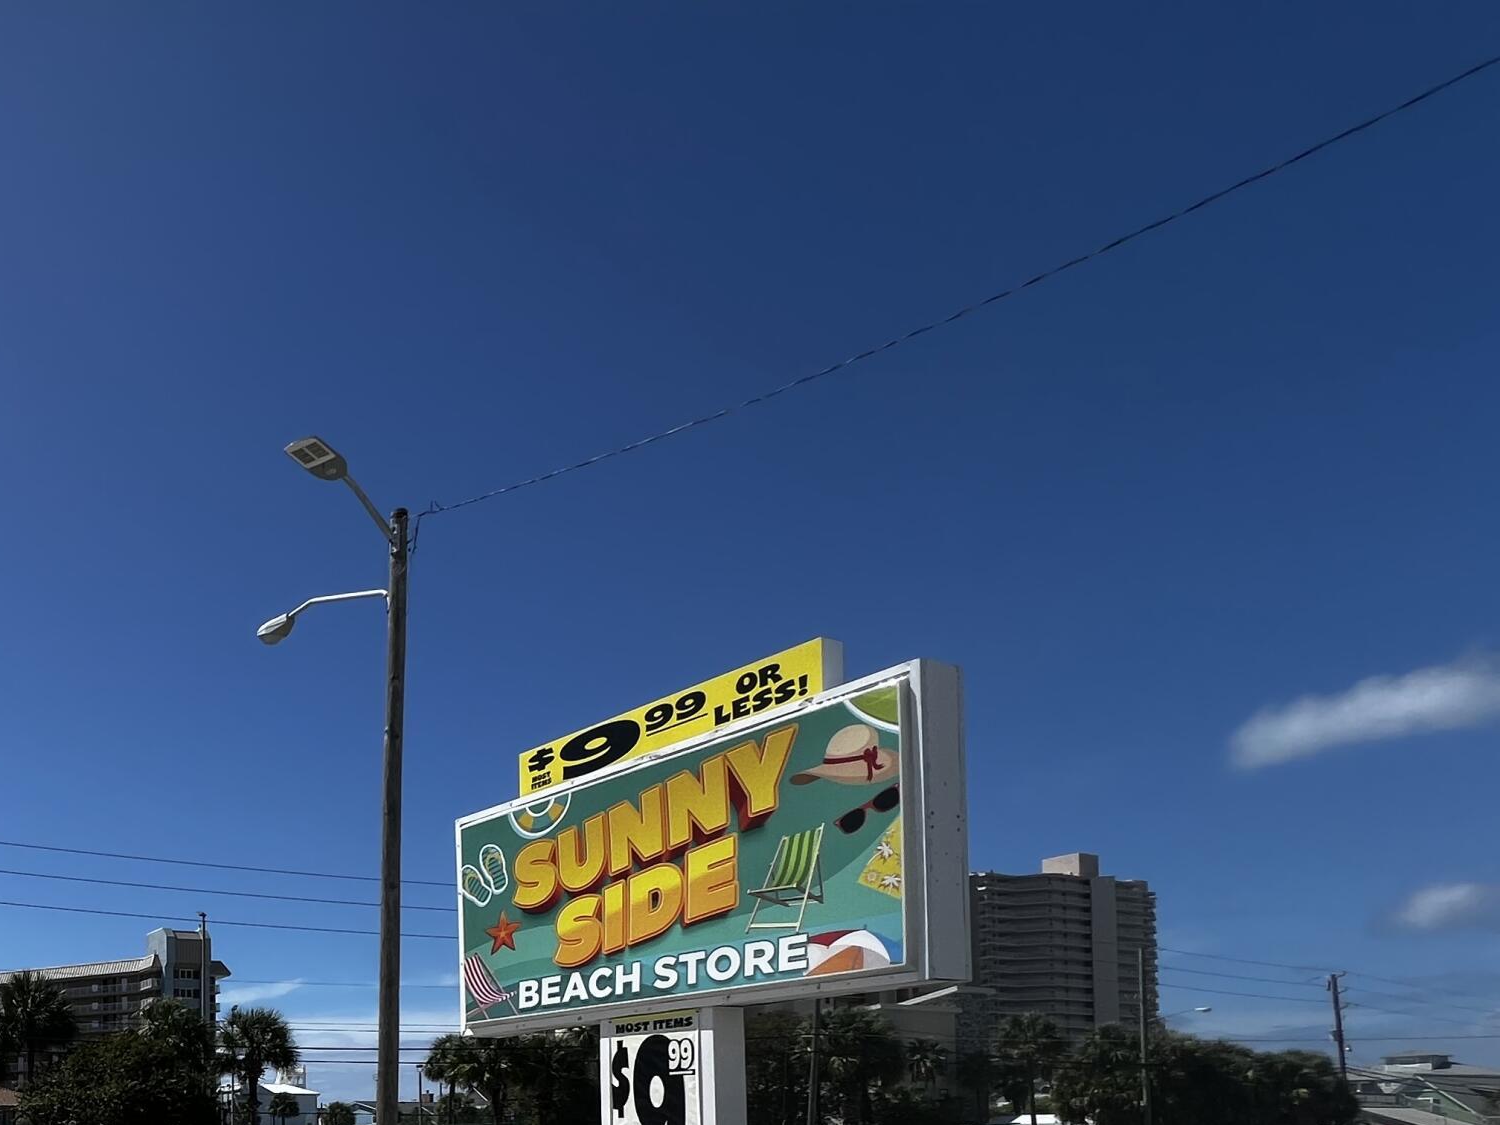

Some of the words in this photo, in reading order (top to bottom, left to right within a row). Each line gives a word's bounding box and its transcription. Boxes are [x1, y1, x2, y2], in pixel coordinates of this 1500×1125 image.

[714, 674, 808, 726] LESS!
[736, 663, 783, 695] OR
[531, 771, 551, 783] MOST
[531, 777, 552, 790] ITEMS
[512, 724, 799, 914] SUNNY
[555, 834, 739, 969] SIDE
[518, 961, 641, 1010] BEACH
[652, 934, 810, 991] STORE
[615, 1021, 650, 1034] MOST
[653, 1016, 693, 1030] ITEMS
